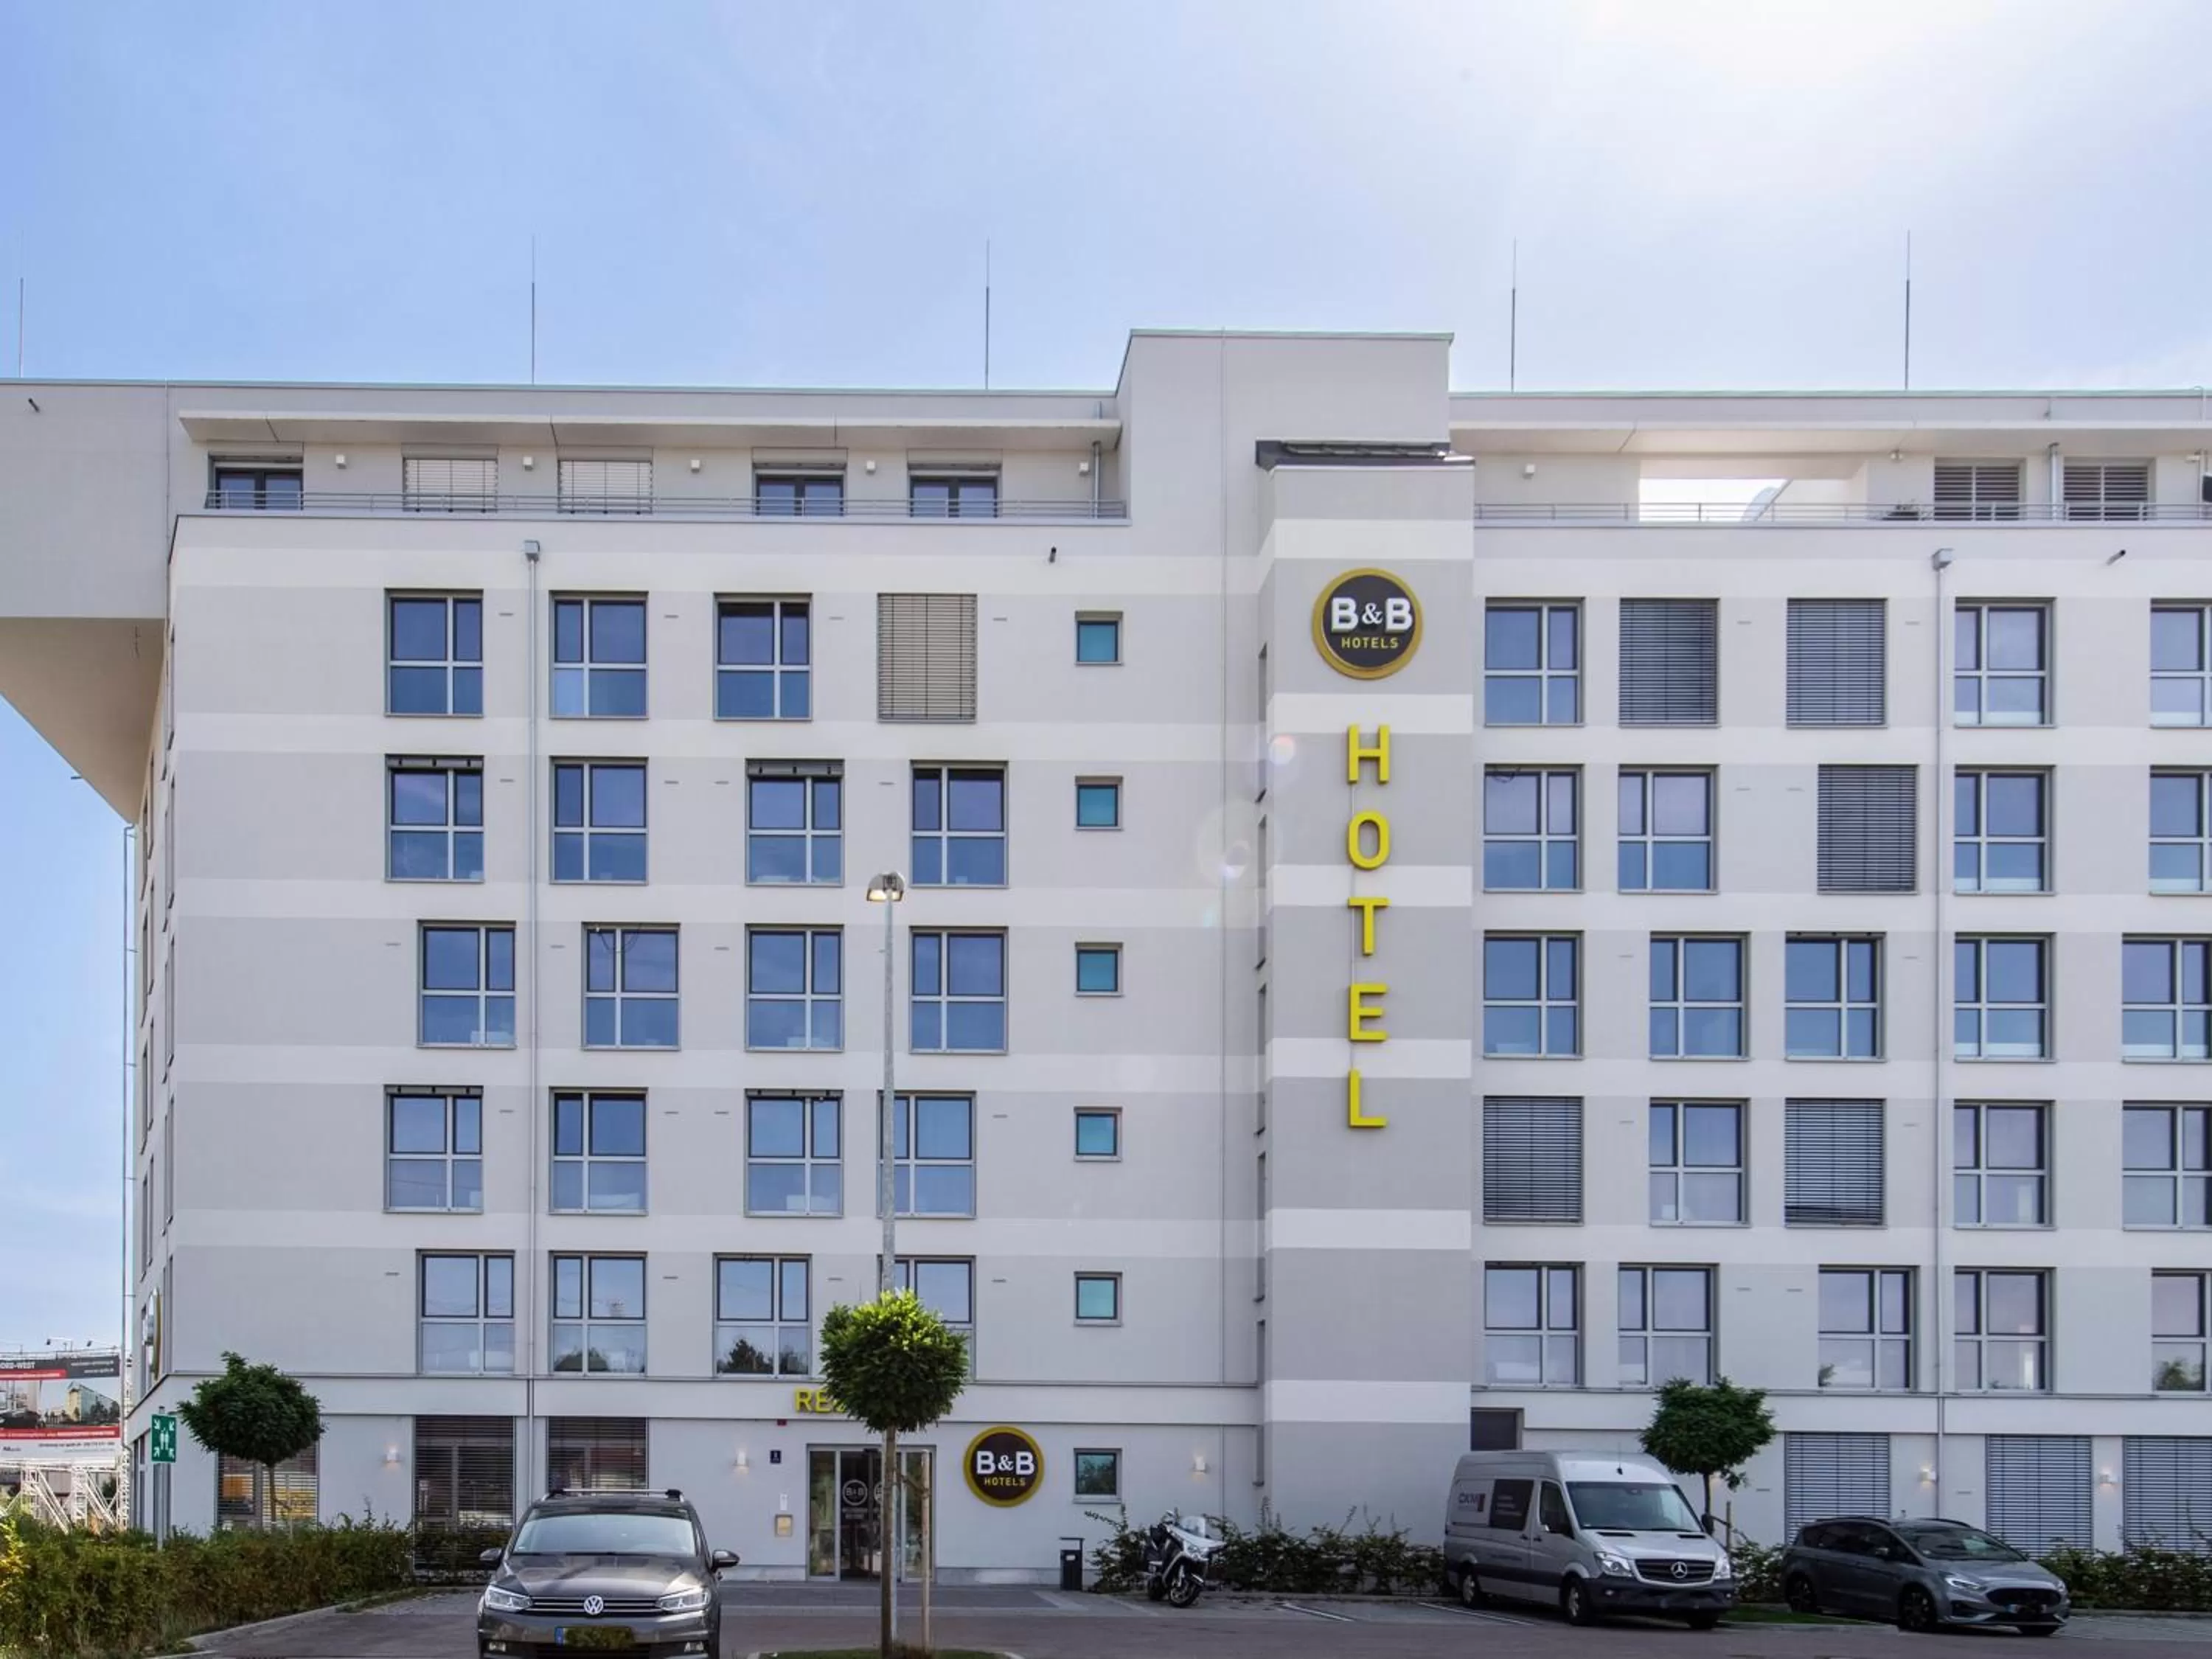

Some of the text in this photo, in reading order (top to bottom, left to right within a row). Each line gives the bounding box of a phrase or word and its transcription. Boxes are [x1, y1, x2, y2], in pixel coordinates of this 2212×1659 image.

[1331, 597, 1413, 632] B&B
[1341, 636, 1399, 649] HOTELS
[1348, 724, 1390, 1128] HOTEL
[977, 1450, 1035, 1475] B&B
[984, 1477, 1026, 1486] HOTELS
